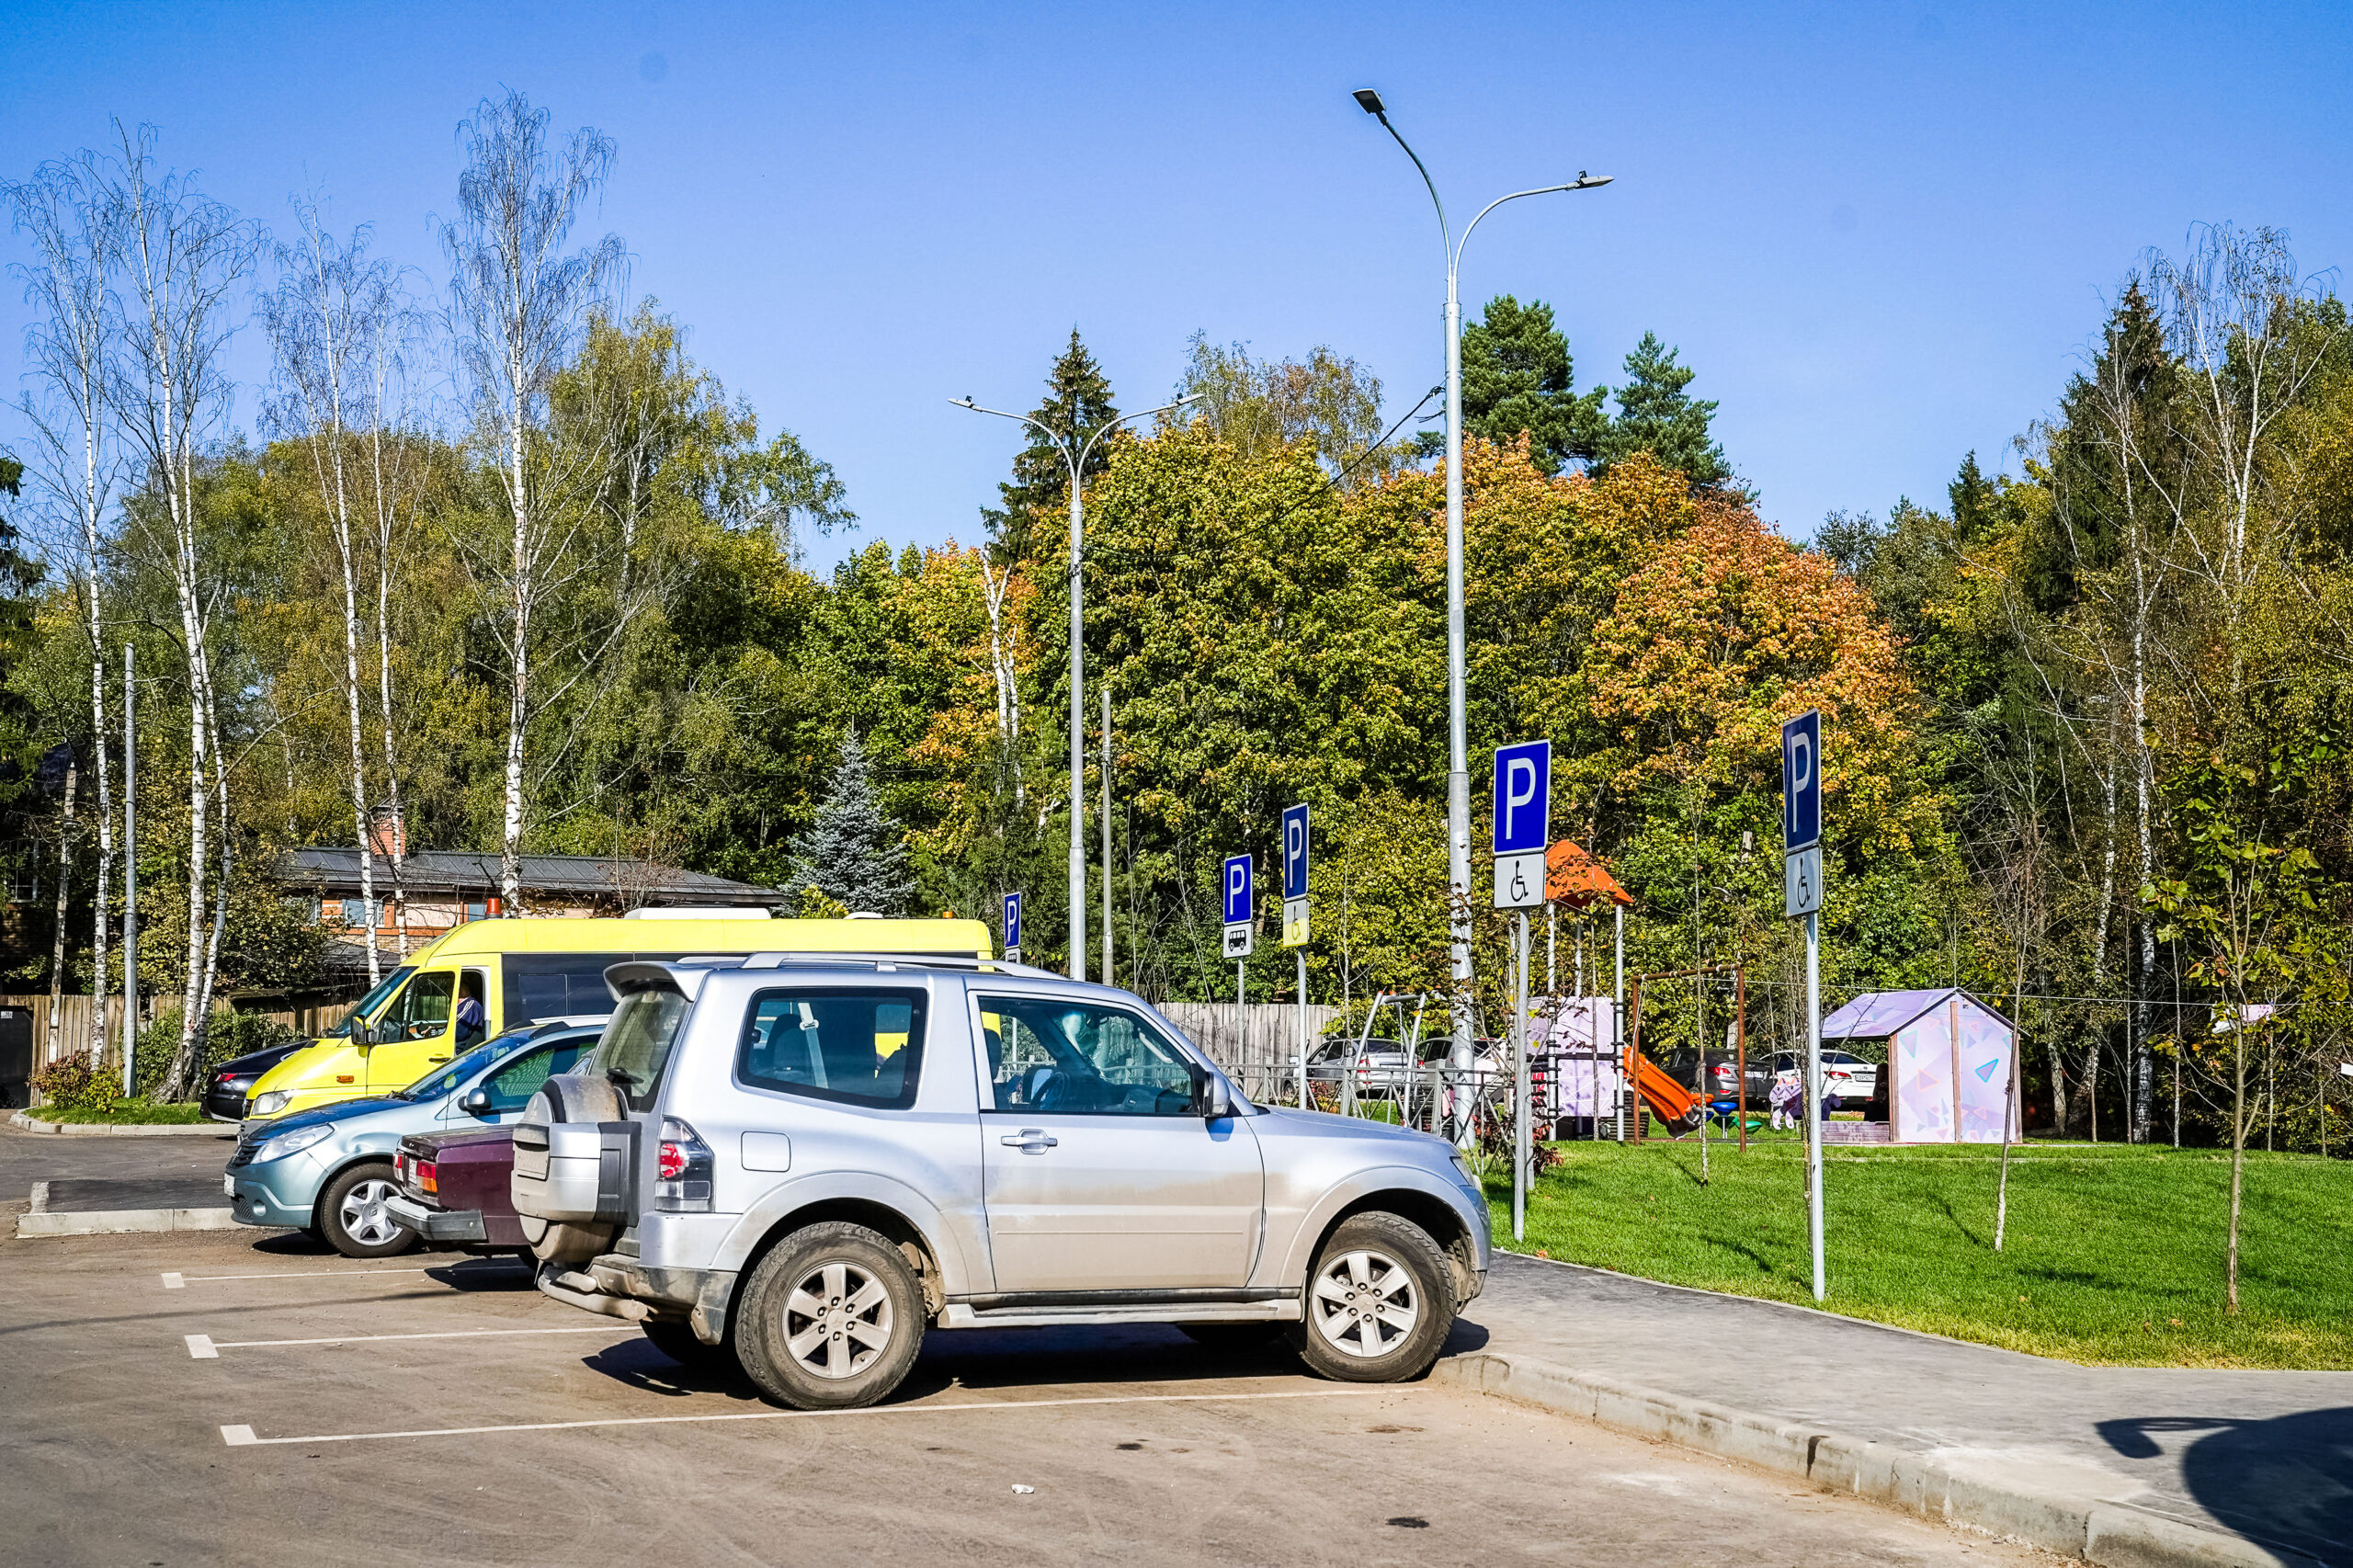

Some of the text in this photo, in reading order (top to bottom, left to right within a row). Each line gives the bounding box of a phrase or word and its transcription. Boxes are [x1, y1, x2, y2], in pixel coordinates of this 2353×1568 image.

[1506, 757, 1536, 840] P
[1791, 733, 1811, 833] P
[1289, 818, 1302, 889] P
[1007, 900, 1017, 942] P
[1230, 864, 1245, 915] P
